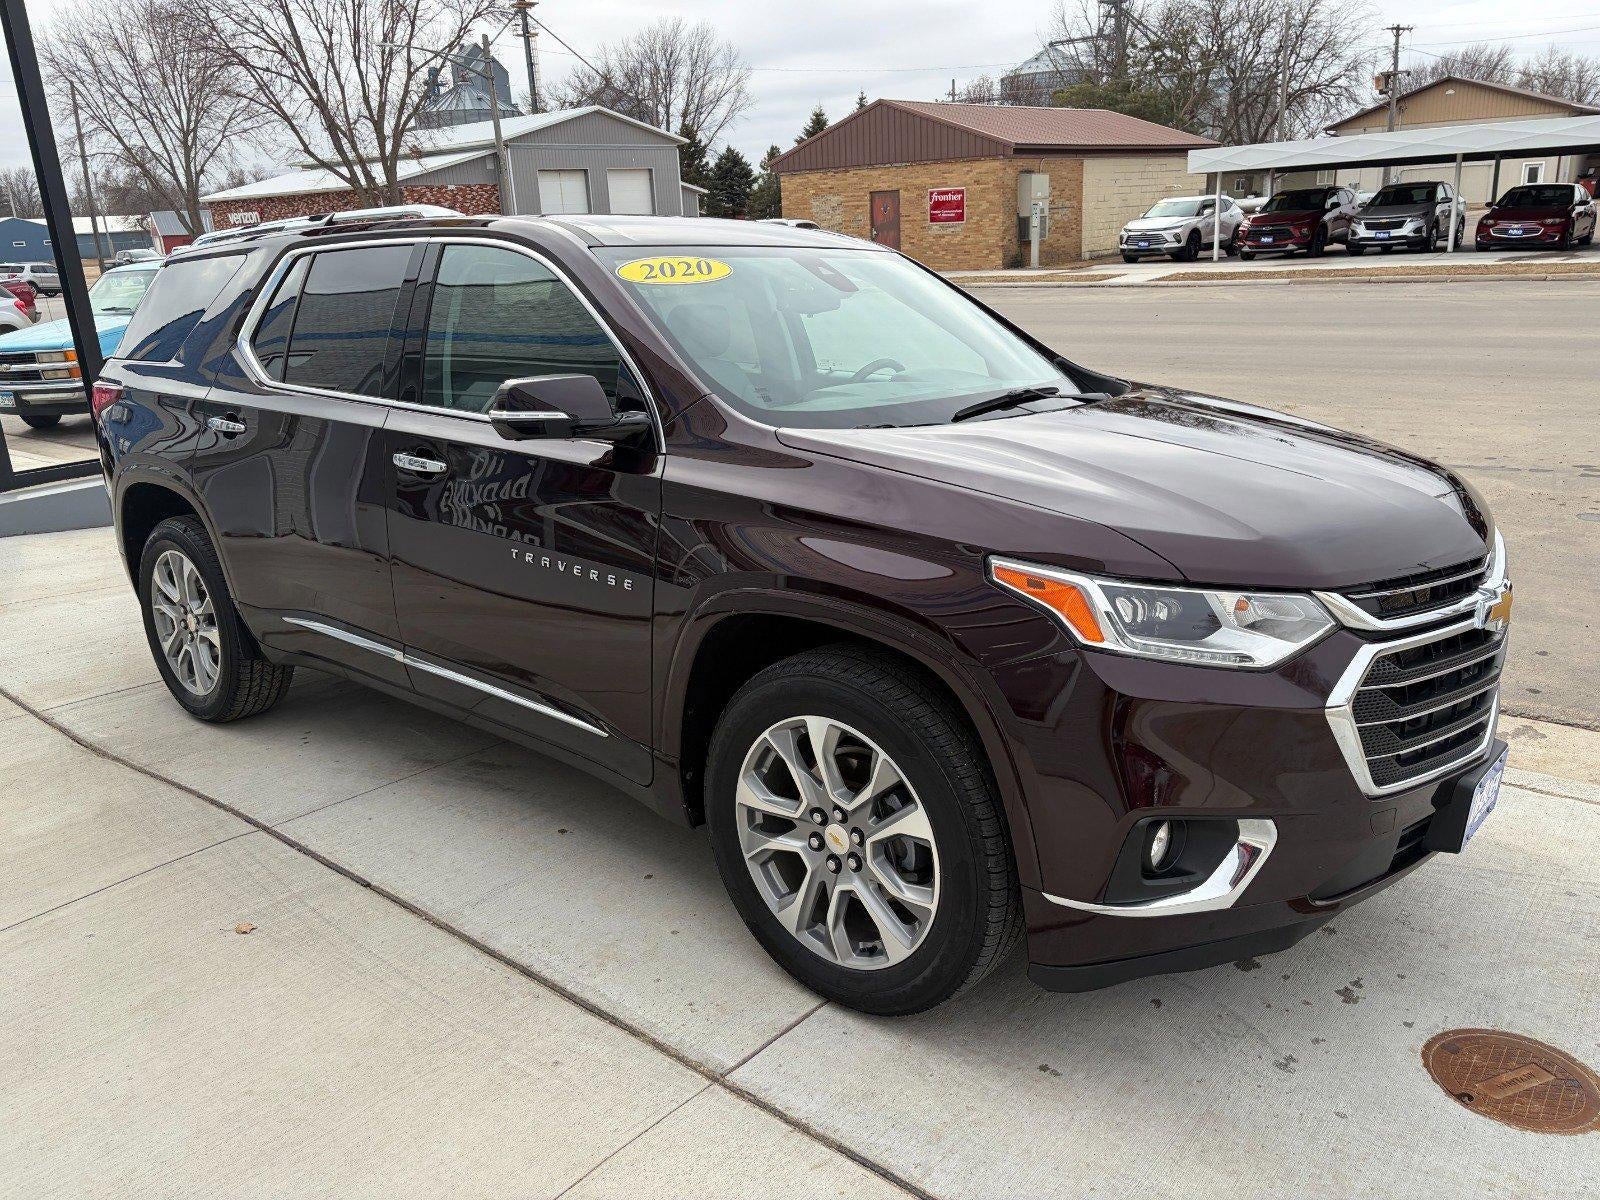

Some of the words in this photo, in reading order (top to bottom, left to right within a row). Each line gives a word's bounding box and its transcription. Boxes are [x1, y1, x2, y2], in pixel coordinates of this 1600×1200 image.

[929, 191, 963, 205] frontier
[227, 208, 261, 225] verizon
[639, 260, 713, 280] 2020
[510, 548, 634, 591] TRAVERSE
